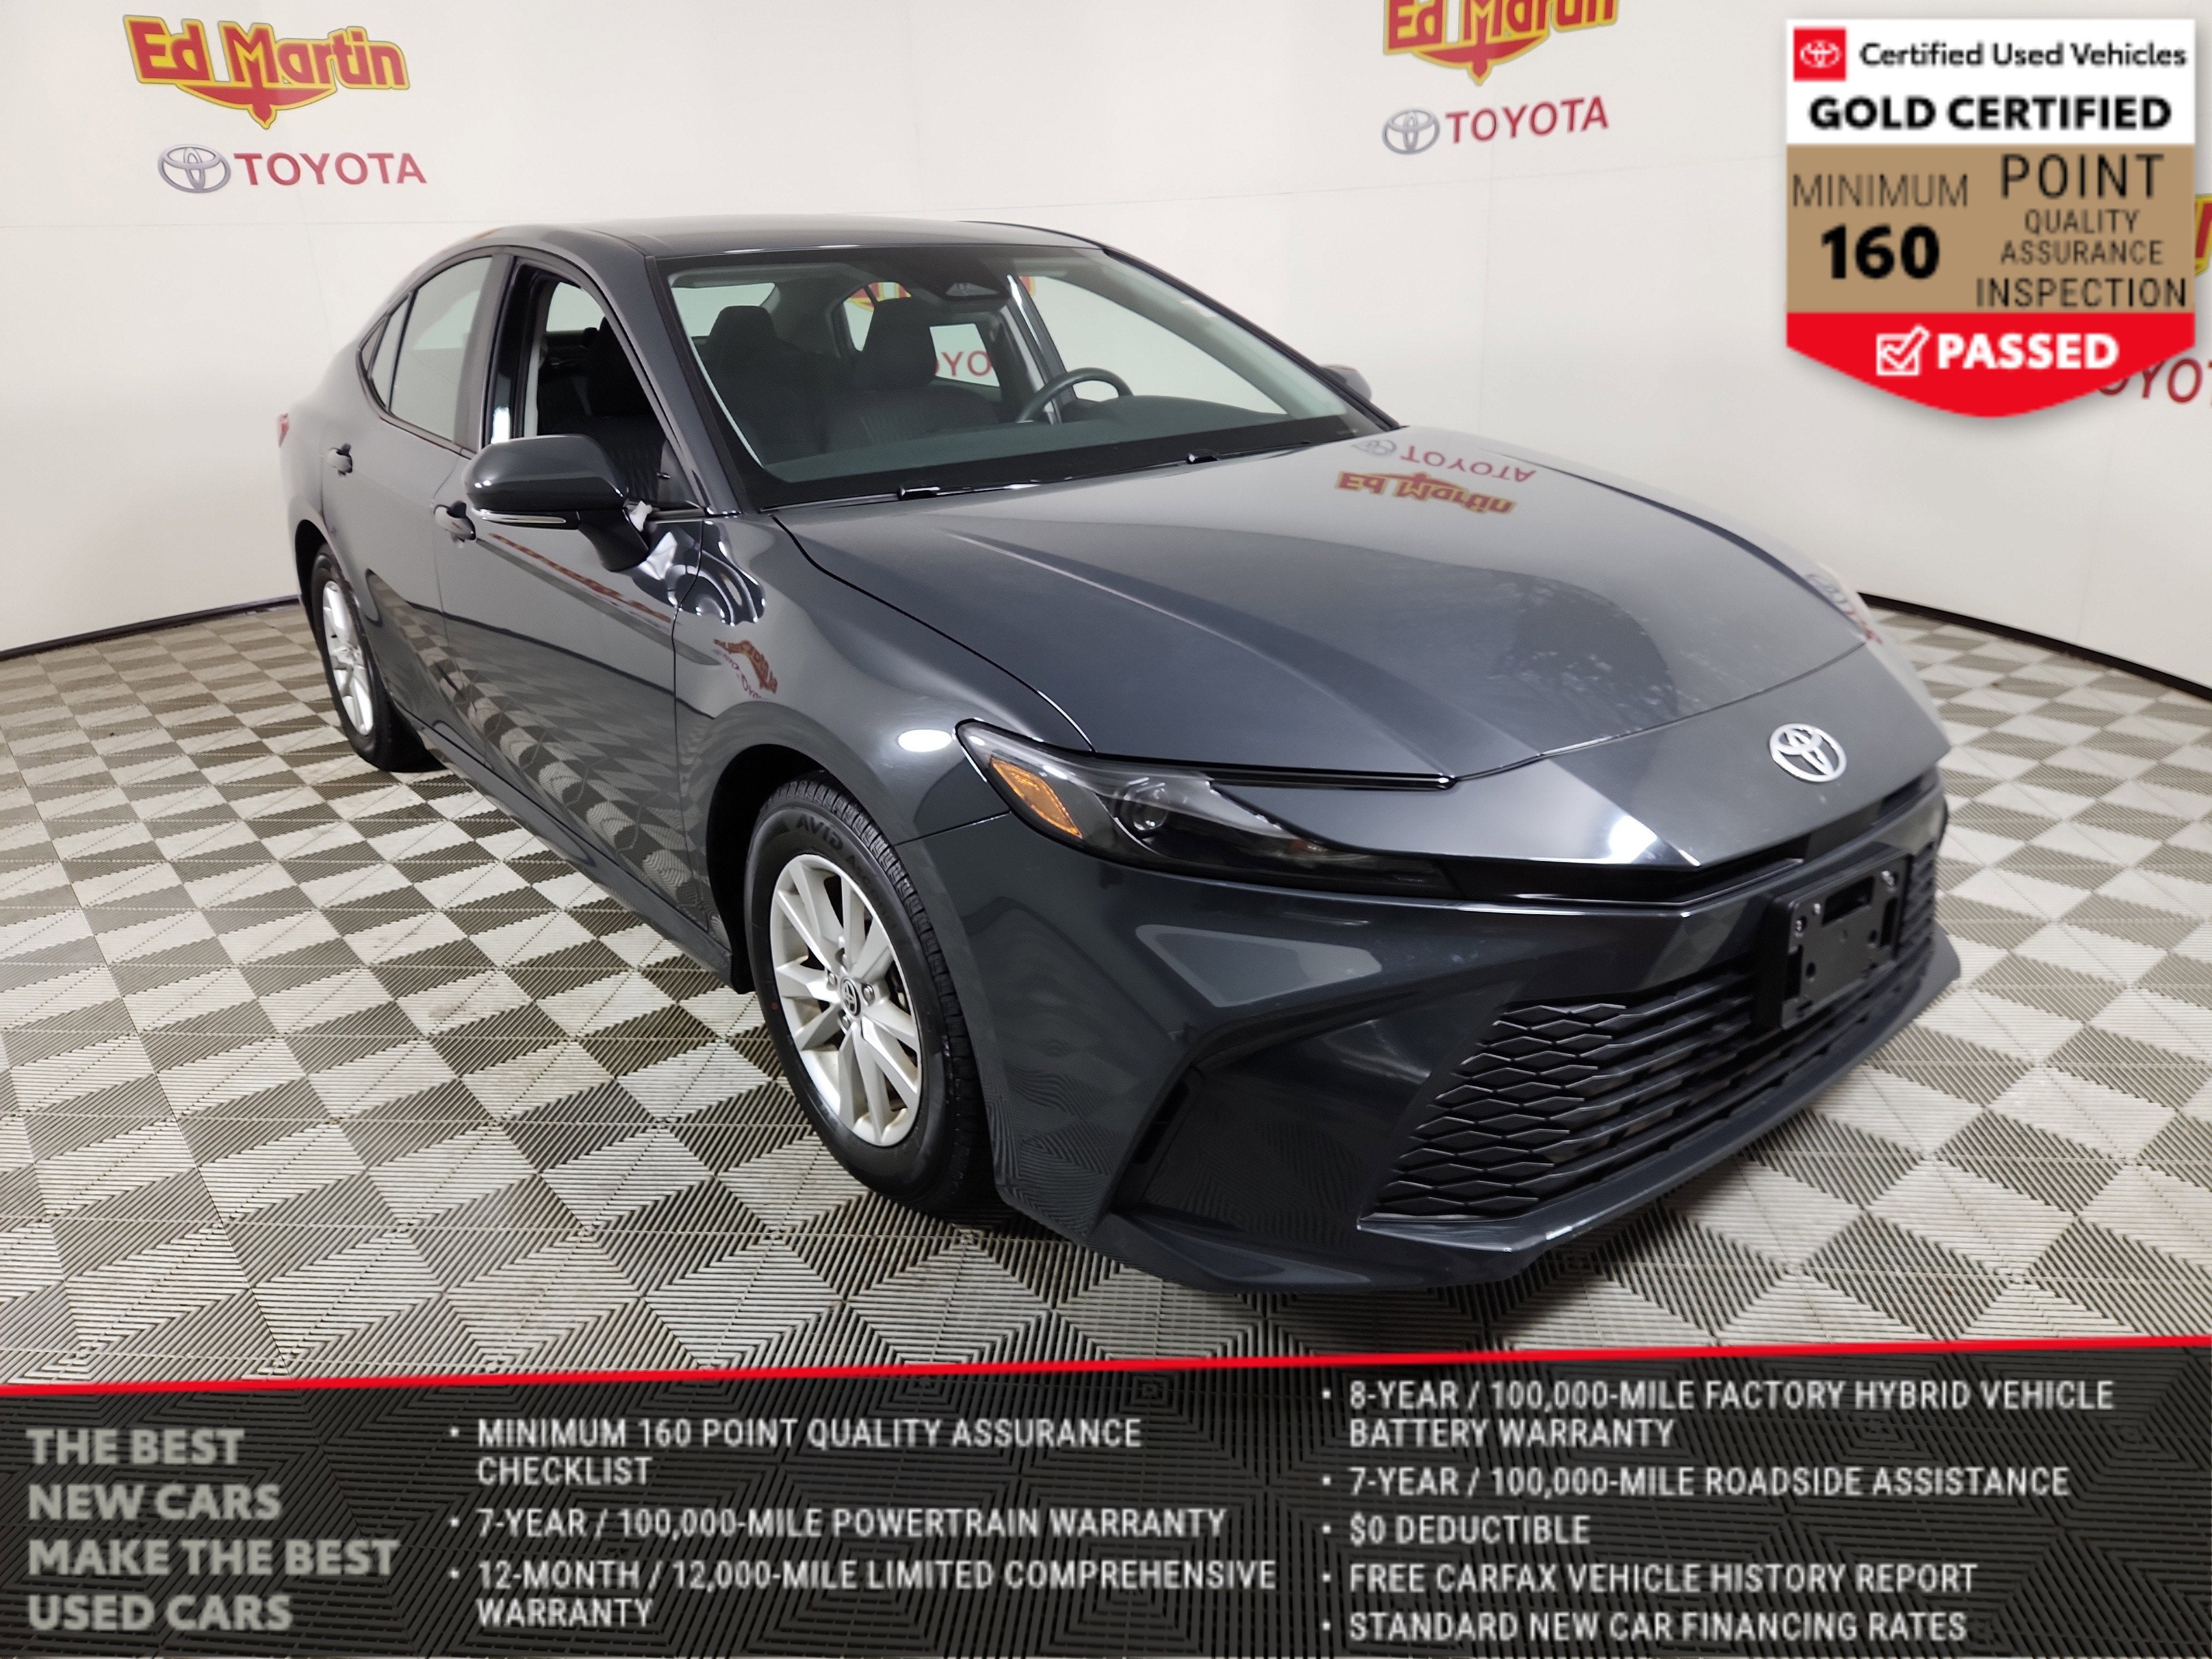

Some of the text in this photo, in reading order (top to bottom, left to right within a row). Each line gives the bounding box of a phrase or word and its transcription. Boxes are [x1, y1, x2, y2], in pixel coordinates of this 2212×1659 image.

[128, 20, 404, 87] Ed Martin
[1445, 95, 1609, 143] TOYOTA
[234, 152, 427, 186] TOYOTA
